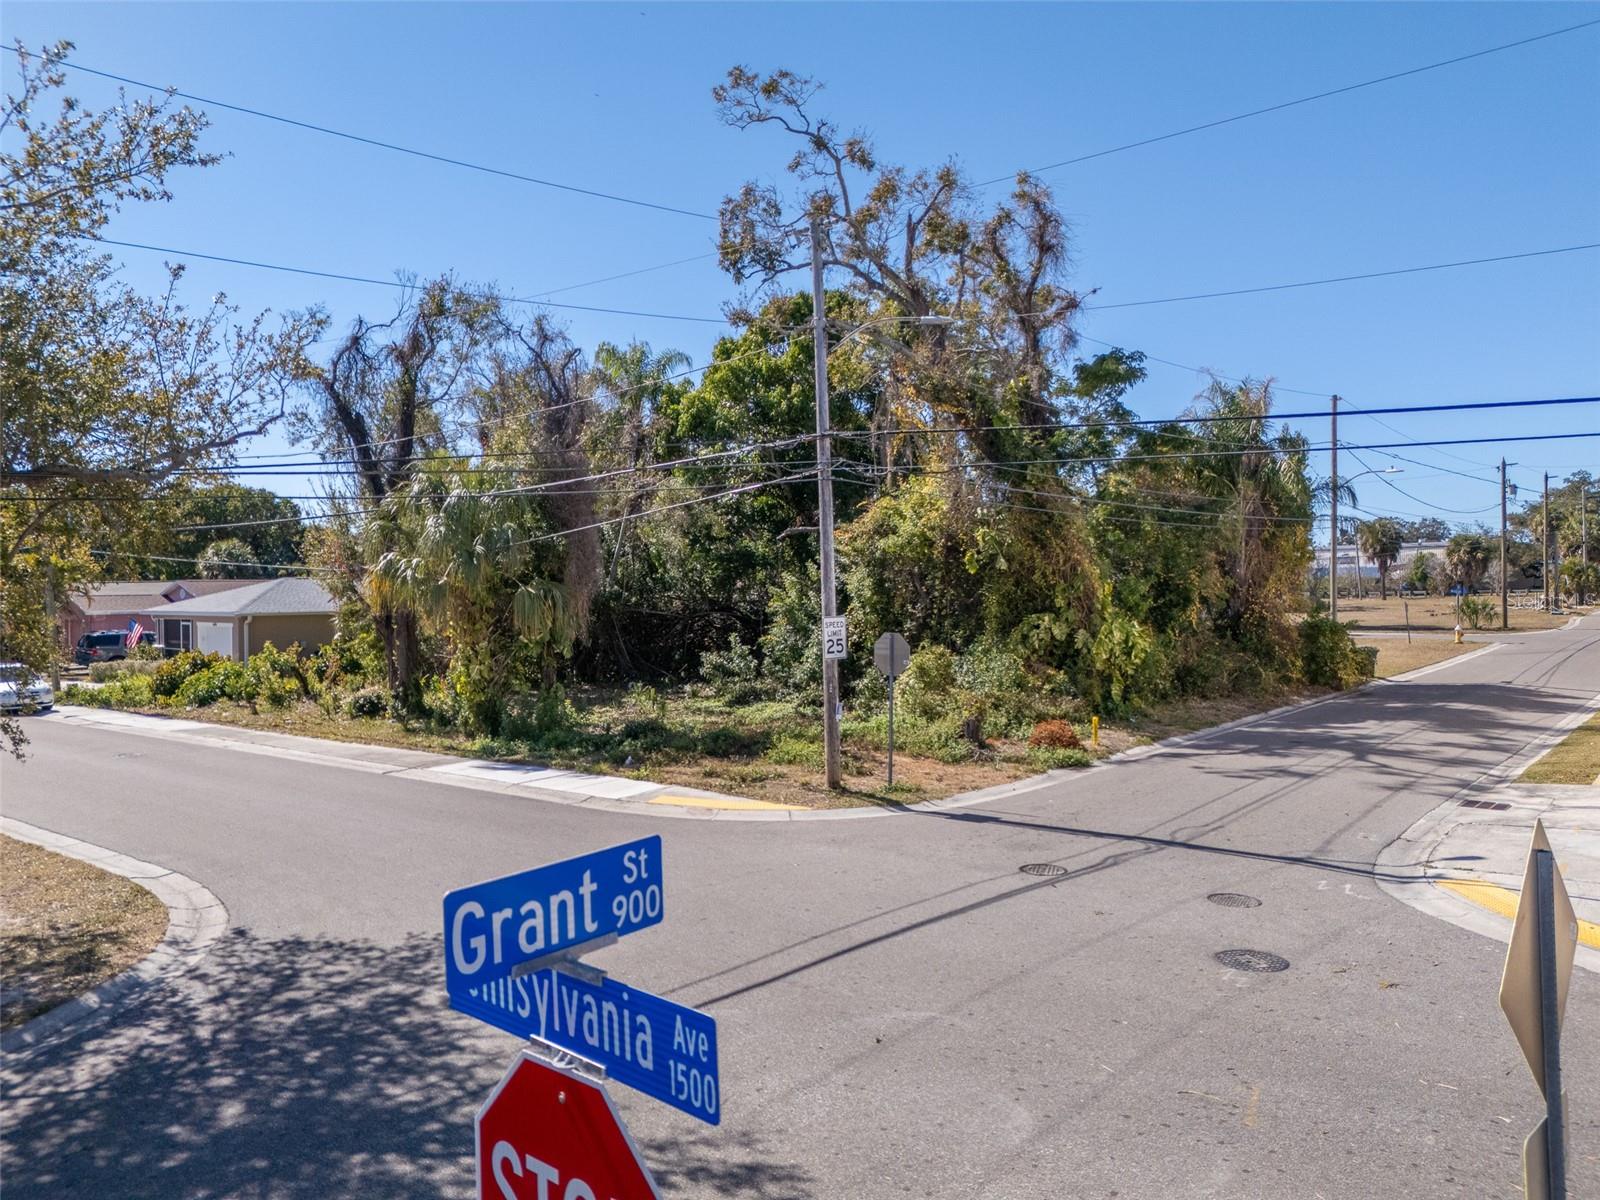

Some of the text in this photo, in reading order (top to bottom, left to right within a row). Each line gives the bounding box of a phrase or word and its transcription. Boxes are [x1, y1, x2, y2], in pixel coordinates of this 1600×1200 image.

[825, 621, 844, 629] SPEED
[826, 639, 844, 655] 25
[623, 848, 649, 884] St
[452, 869, 598, 975] Grant
[612, 884, 660, 929] 900
[673, 1014, 708, 1062] Ave
[669, 1059, 716, 1115] 1500
